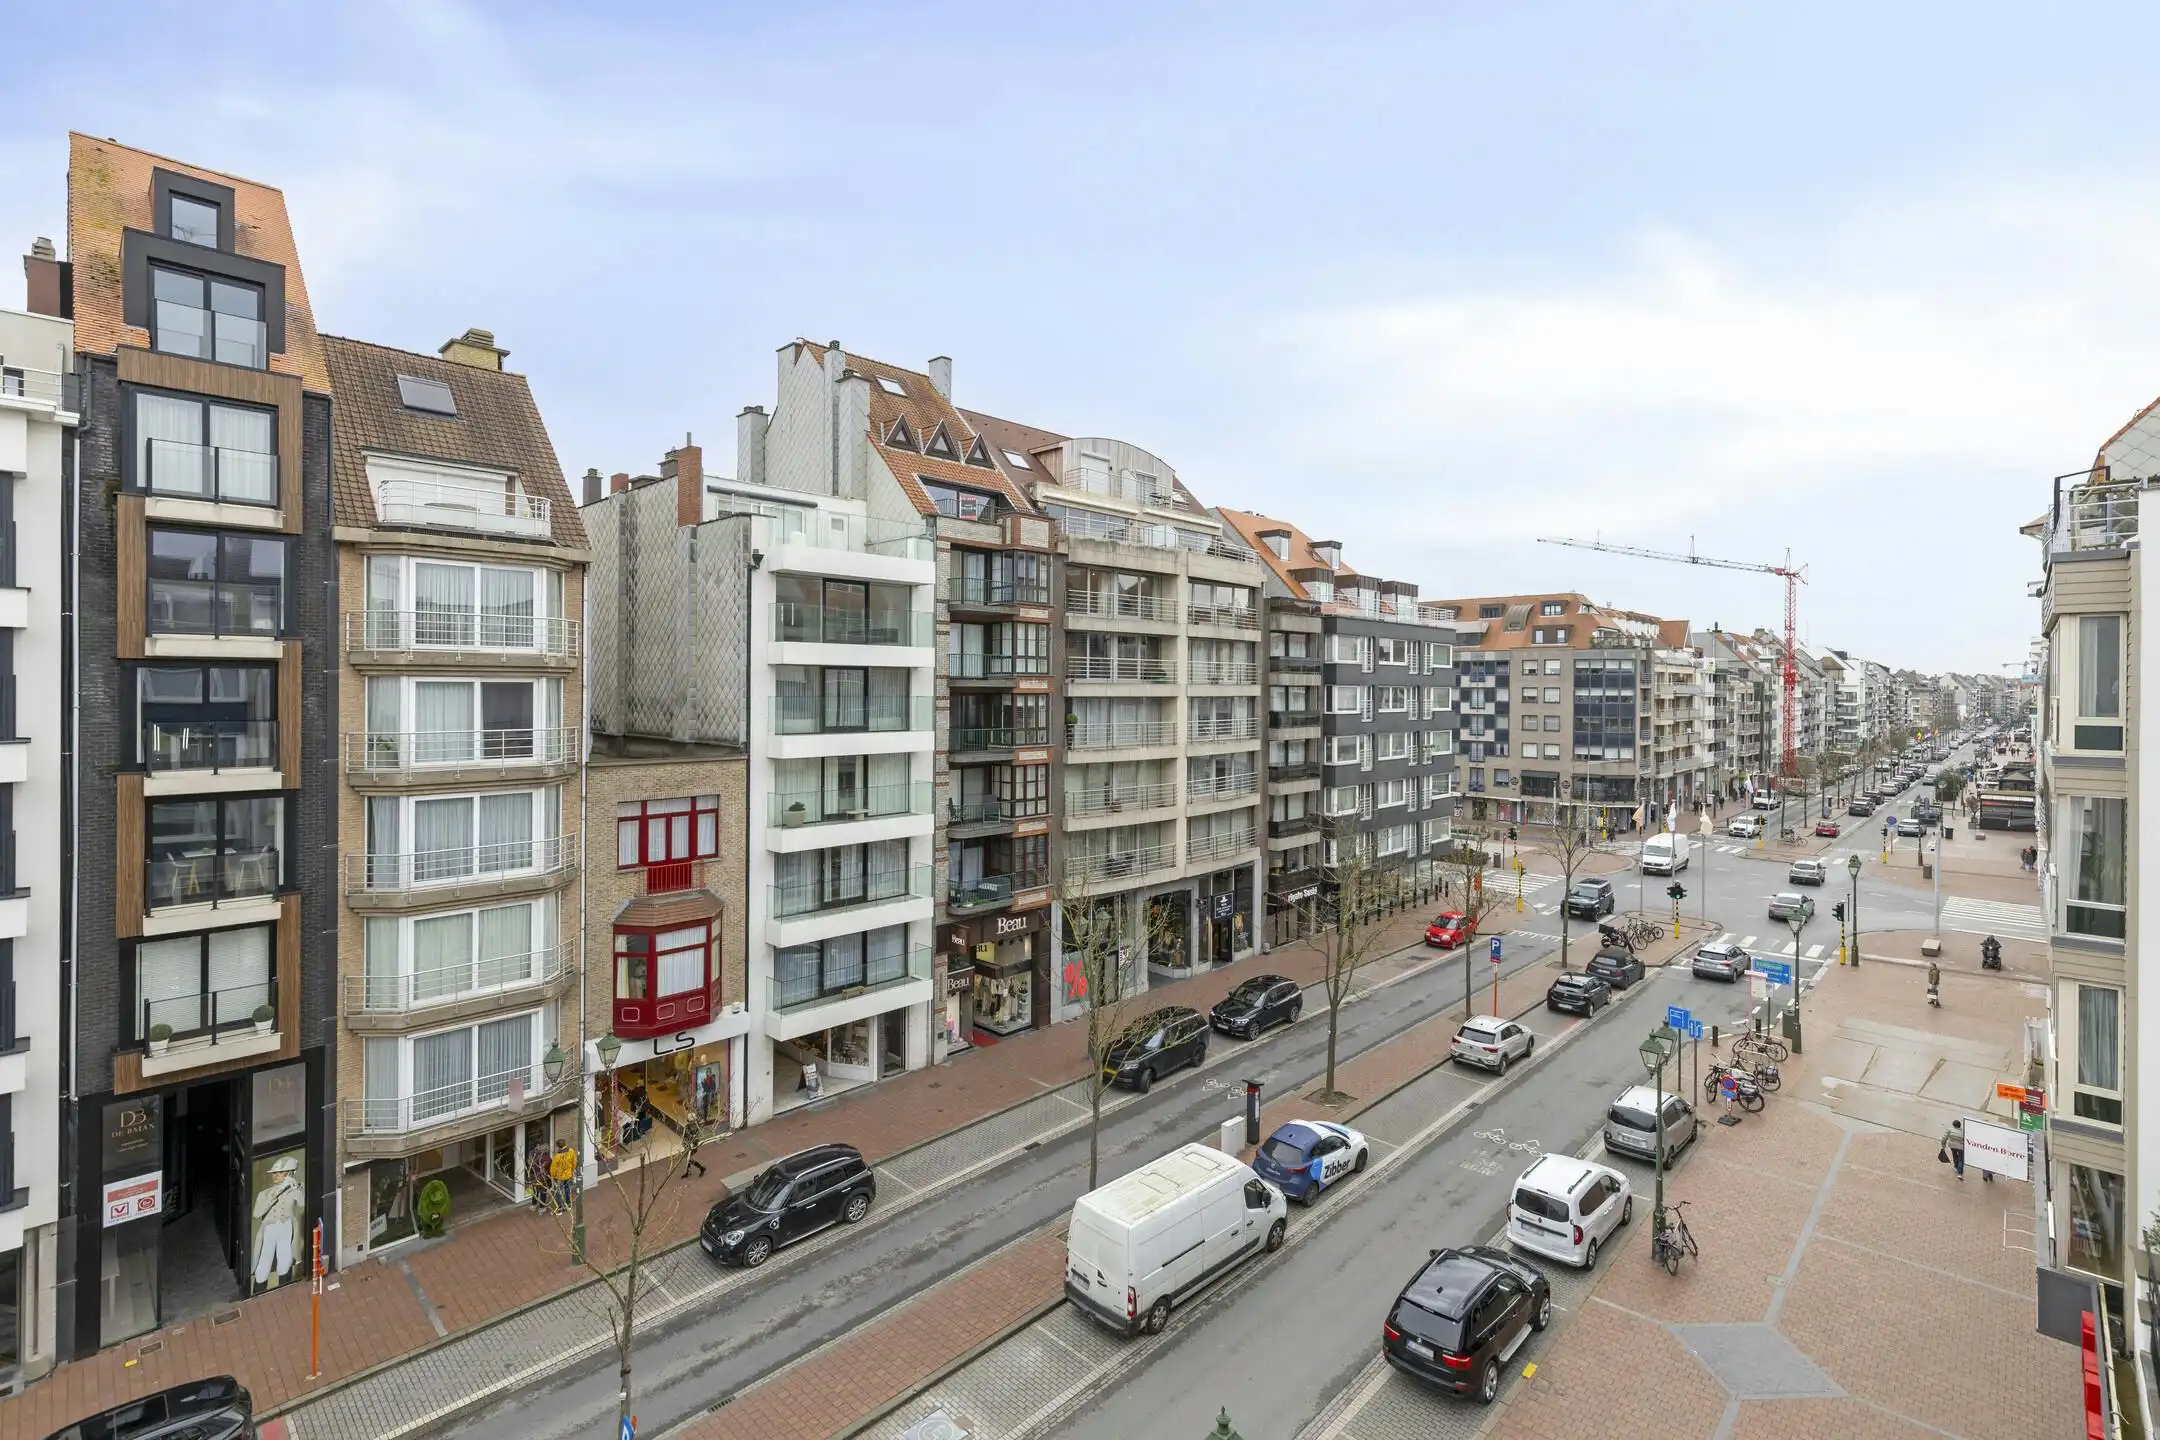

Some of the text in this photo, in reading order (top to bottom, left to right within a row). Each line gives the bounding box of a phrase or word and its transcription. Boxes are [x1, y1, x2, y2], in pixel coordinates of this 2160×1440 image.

[996, 917, 1028, 935] Beau
[951, 933, 965, 946] Beau
[1492, 939, 1500, 951] P
[947, 977, 970, 991] Beau
[653, 1031, 696, 1056] LS
[1966, 1138, 2026, 1159] Vanden Borre
[1324, 1158, 1351, 1179] Zibber
